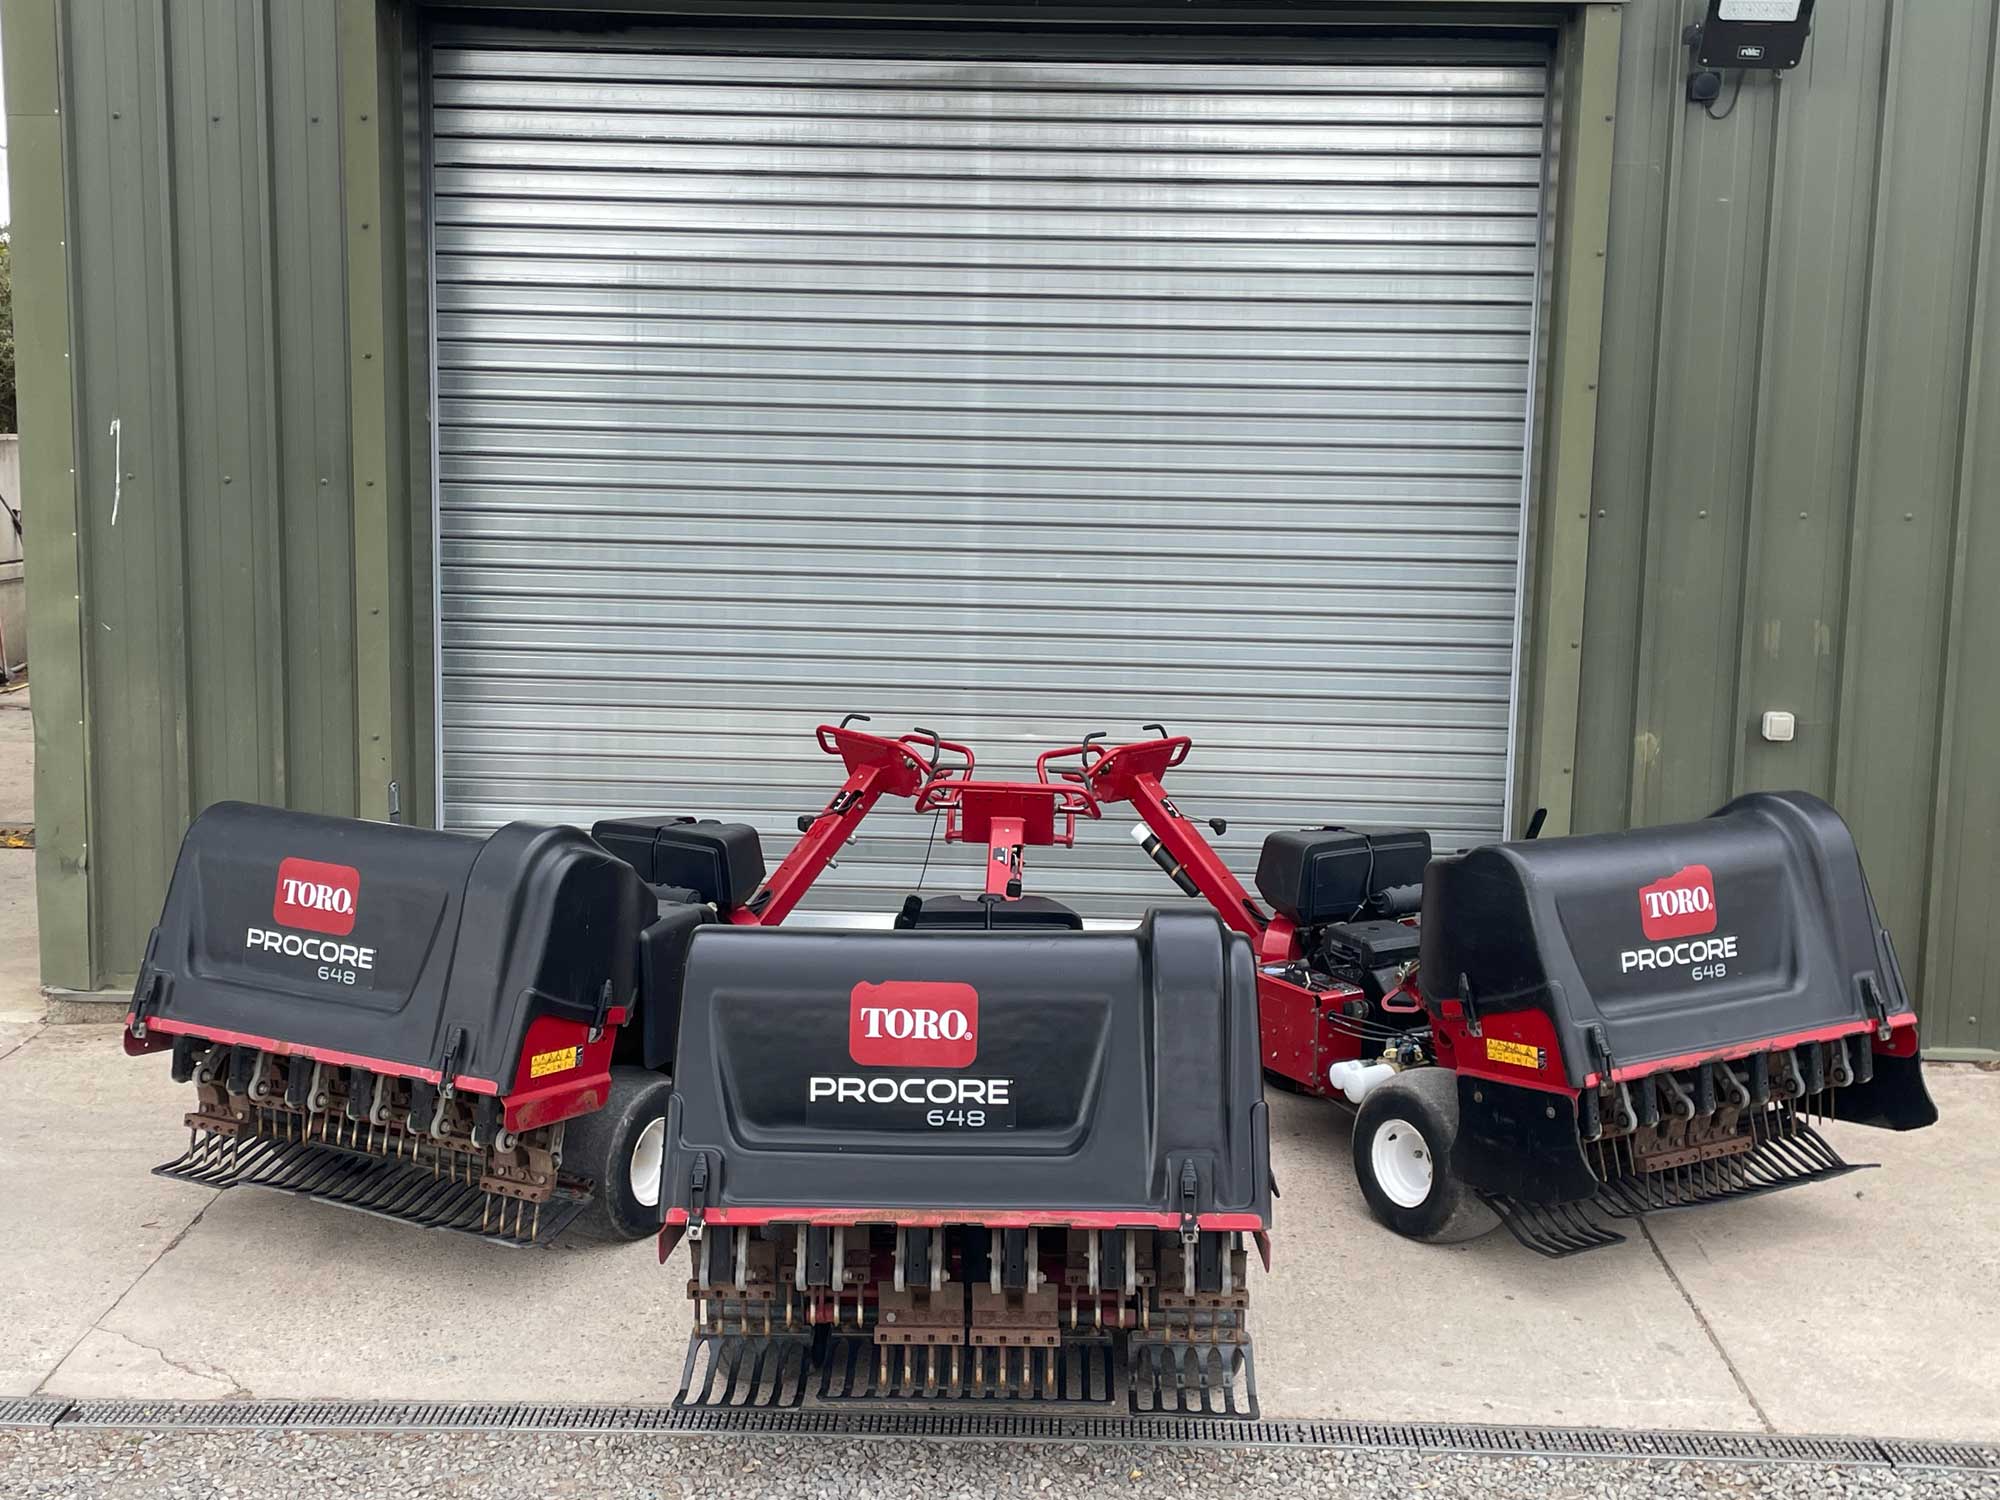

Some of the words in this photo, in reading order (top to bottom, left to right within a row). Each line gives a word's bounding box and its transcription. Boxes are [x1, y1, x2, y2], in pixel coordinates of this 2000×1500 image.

[283, 879, 351, 913] TORO
[1645, 886, 1710, 918] TORO
[247, 928, 375, 969] PROCORE
[1621, 936, 1738, 973] PROCORE
[318, 966, 356, 985] 648
[1692, 964, 1726, 981] 648
[861, 1008, 968, 1040] TORO
[810, 1077, 1010, 1104] PROCORE
[927, 1110, 986, 1126] 648
